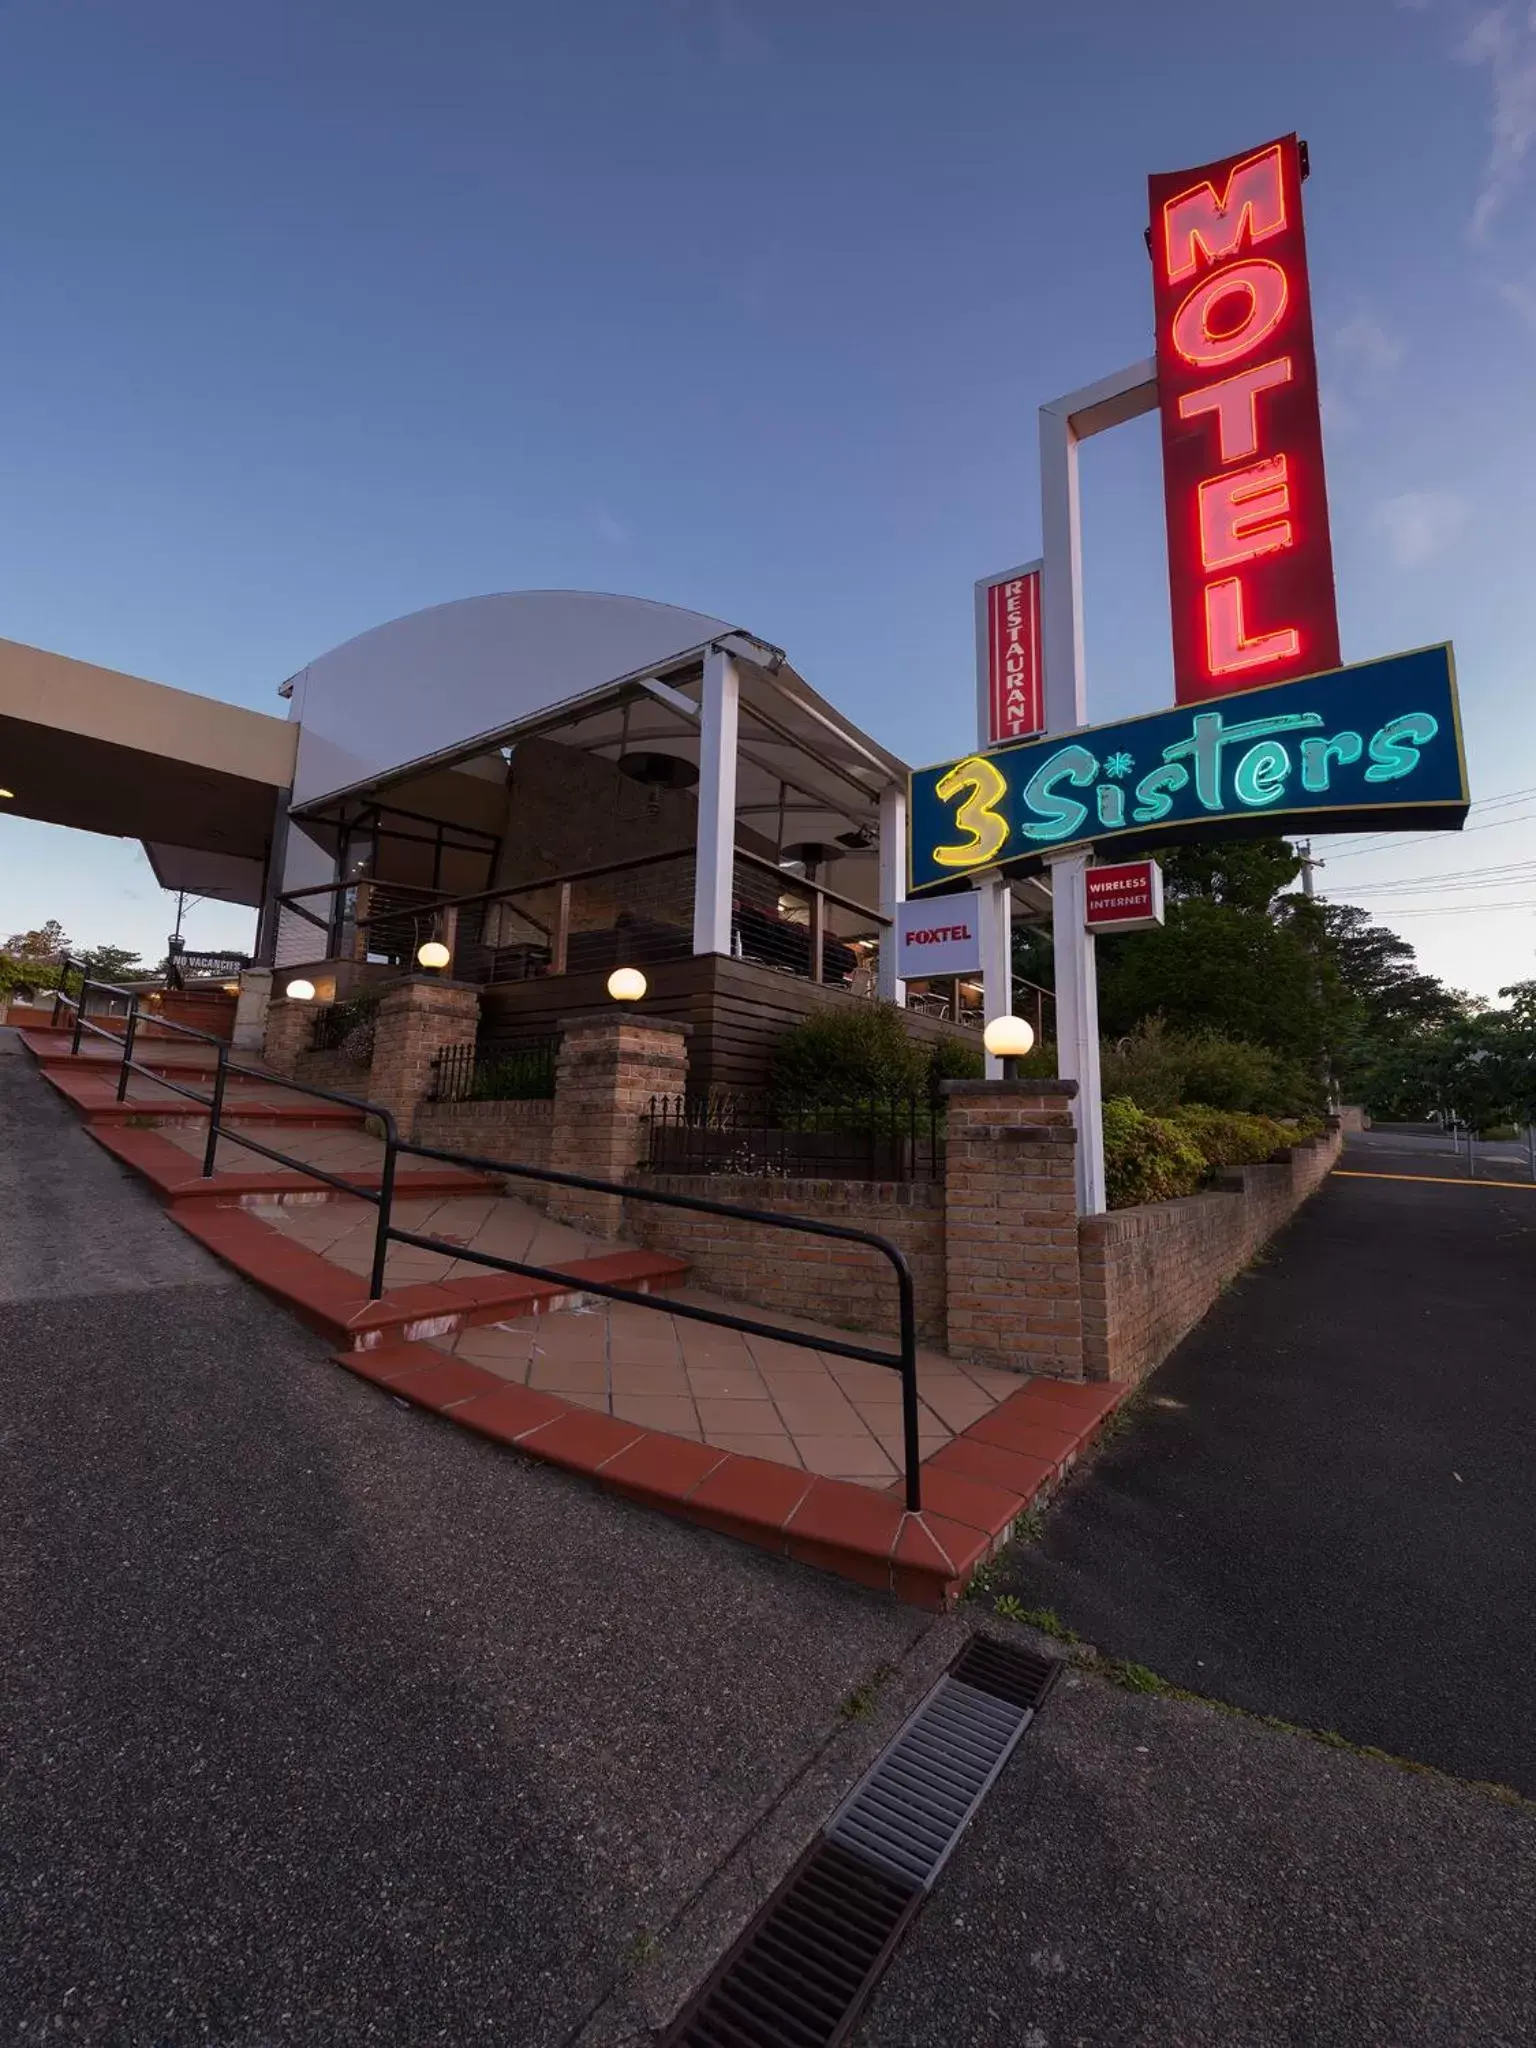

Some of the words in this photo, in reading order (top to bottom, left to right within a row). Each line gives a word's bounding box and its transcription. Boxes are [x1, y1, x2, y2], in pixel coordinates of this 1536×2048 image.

[1163, 144, 1299, 677] MOTEL
[1004, 580, 1026, 736] RESTAURANT
[931, 756, 1011, 867] 3
[1021, 710, 1439, 841] Sisters
[1089, 877, 1147, 893] WIRELESS
[1090, 894, 1148, 910] INTERNET
[905, 925, 972, 947] FOXTEL
